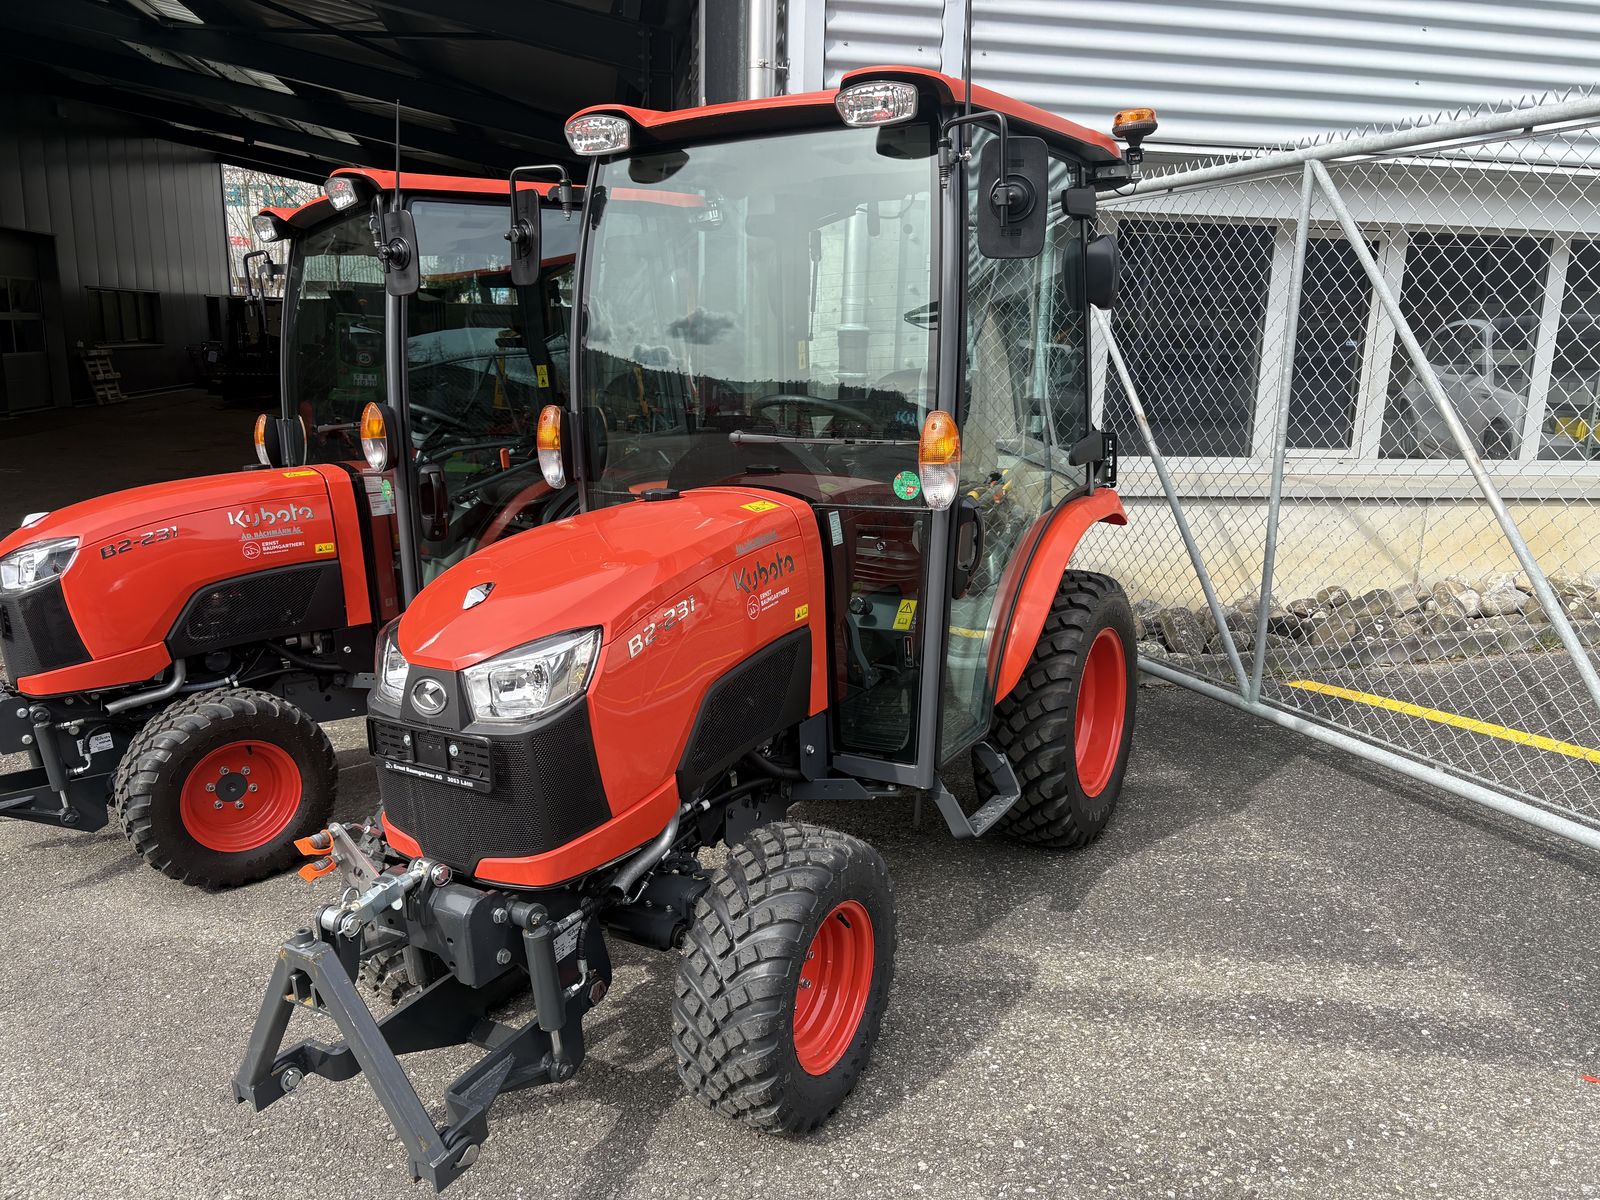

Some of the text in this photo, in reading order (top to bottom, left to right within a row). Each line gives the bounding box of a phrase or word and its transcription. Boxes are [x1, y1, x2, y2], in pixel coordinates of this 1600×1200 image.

[227, 503, 314, 528] Kubota
[100, 525, 178, 560] B2-231
[733, 551, 795, 594] Kubota
[627, 595, 696, 659] B2-231
